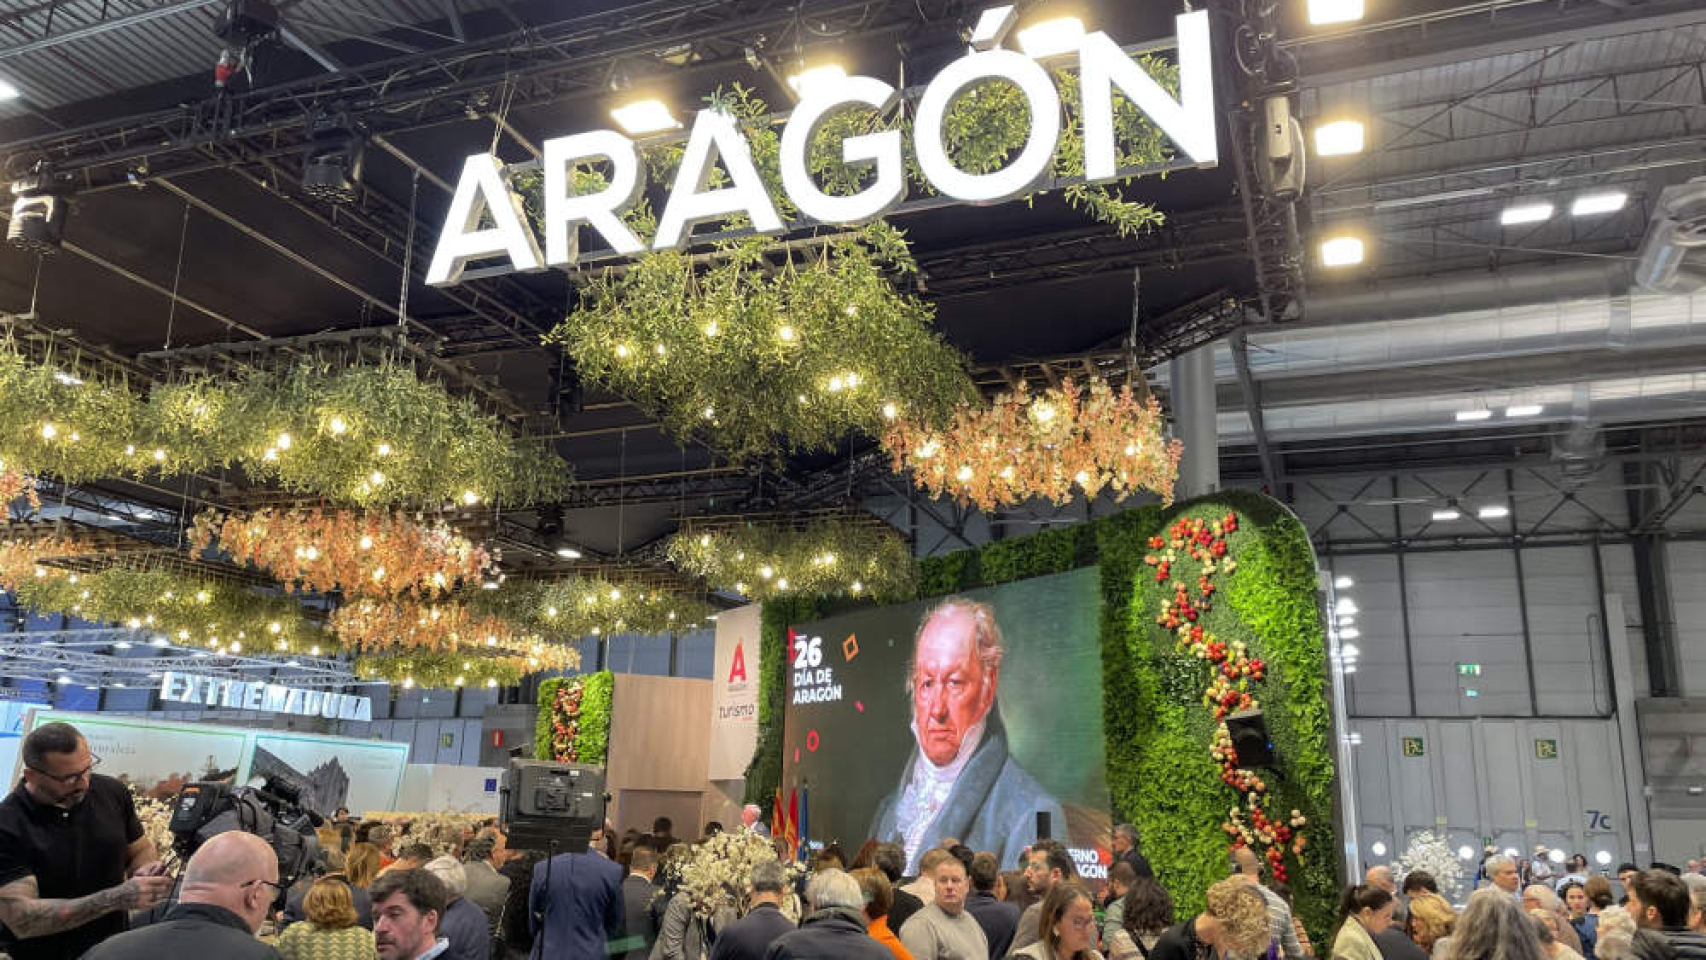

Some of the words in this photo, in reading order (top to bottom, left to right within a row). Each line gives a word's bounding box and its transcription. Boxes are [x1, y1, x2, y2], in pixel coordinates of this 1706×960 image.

[424, 6, 1218, 287] ARAGÓN
[793, 636, 823, 669] 26
[794, 668, 814, 687] DÍA
[816, 668, 833, 685] DE
[159, 671, 372, 722] EXTREMADURA
[792, 684, 842, 705] ARAGÓN
